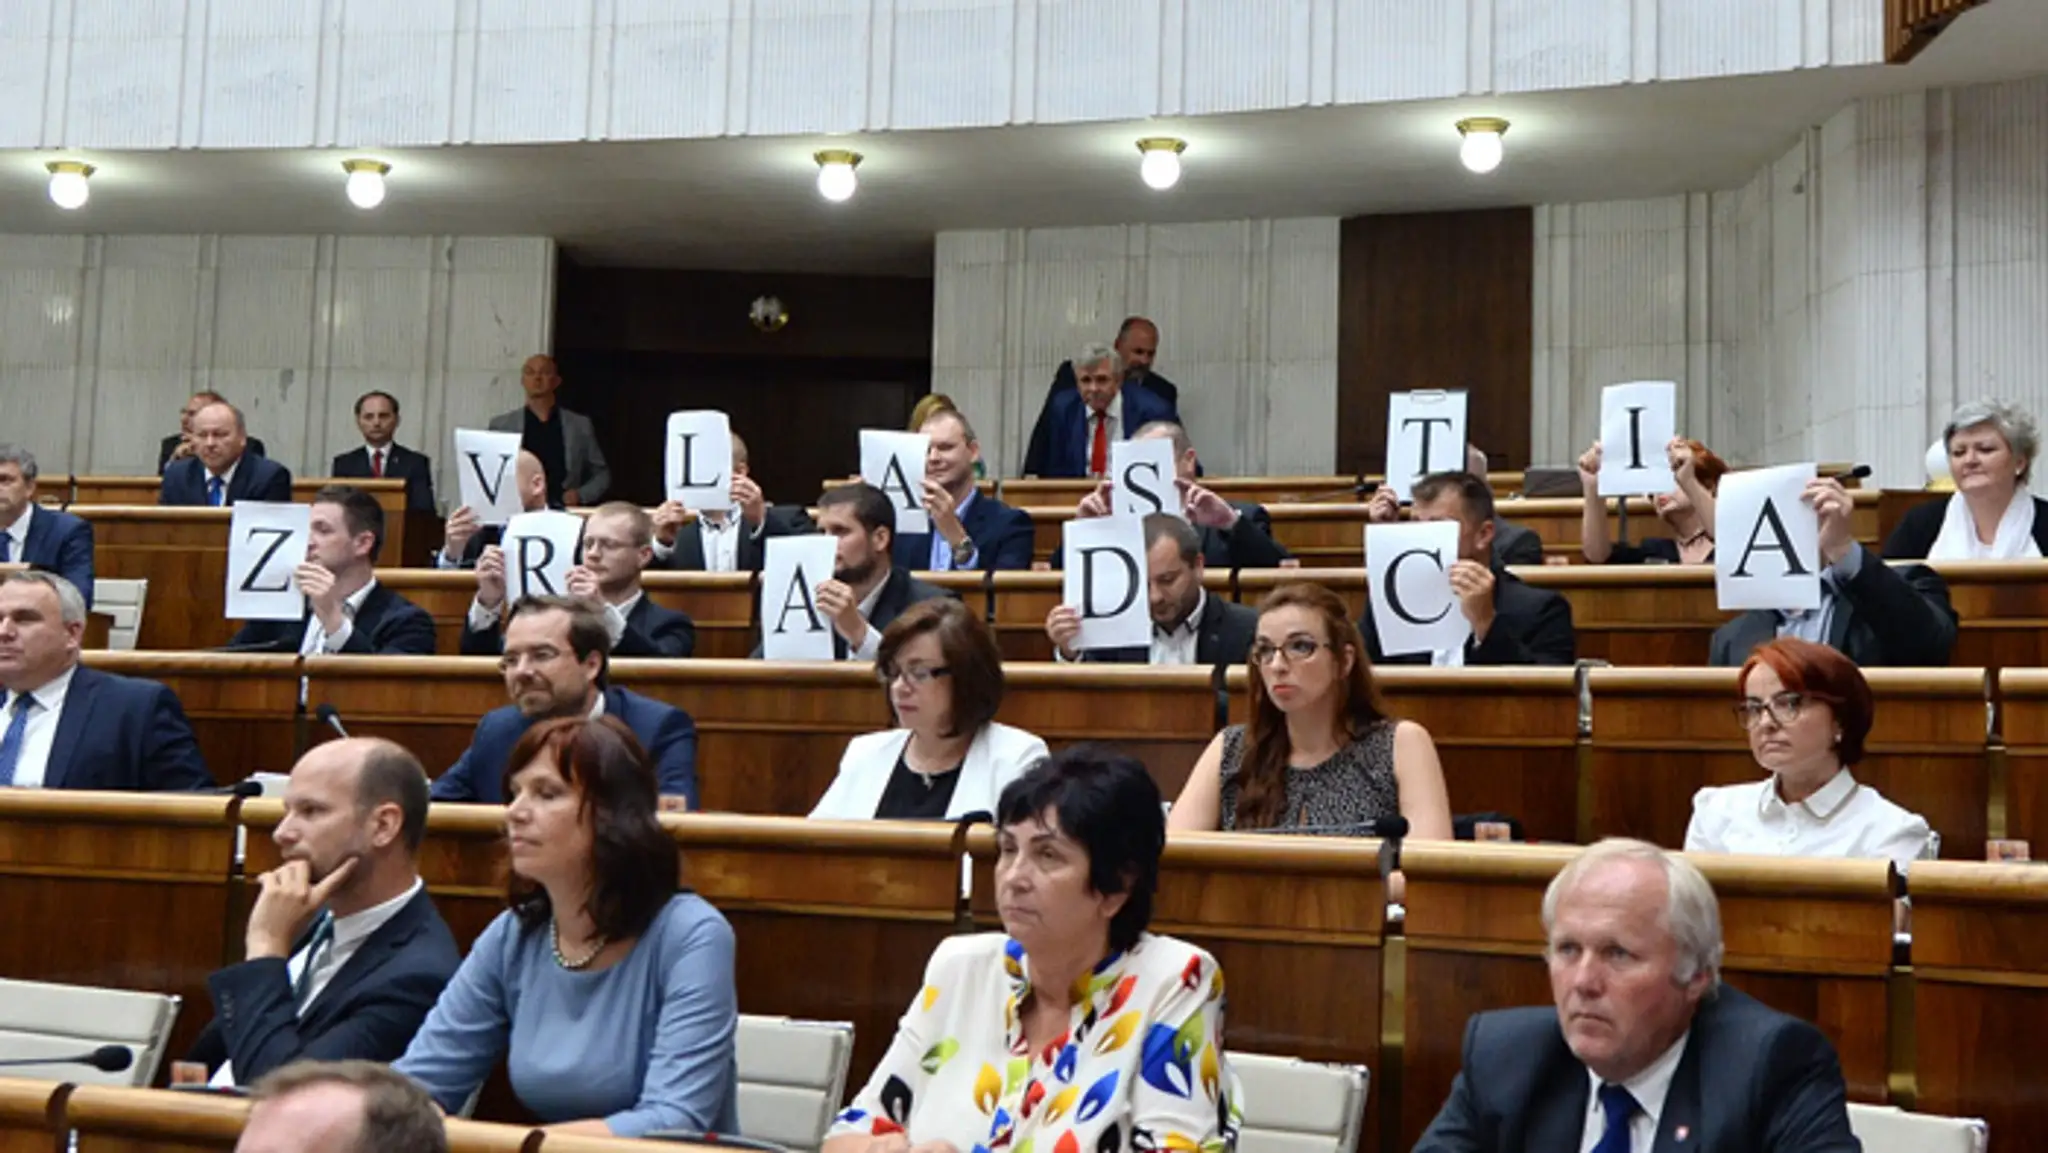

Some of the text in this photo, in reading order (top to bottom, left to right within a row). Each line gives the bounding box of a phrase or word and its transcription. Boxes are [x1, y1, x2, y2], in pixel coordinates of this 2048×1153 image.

[680, 434, 721, 488] L
[1401, 417, 1453, 477] T
[1626, 407, 1647, 469] I
[466, 451, 513, 505] V
[878, 452, 921, 511] A
[1123, 462, 1163, 515] S
[239, 528, 293, 592] Z
[515, 536, 561, 598] R
[1730, 495, 1813, 578] A
[774, 562, 825, 633] A
[1075, 547, 1140, 619] D
[1384, 547, 1452, 625] C
